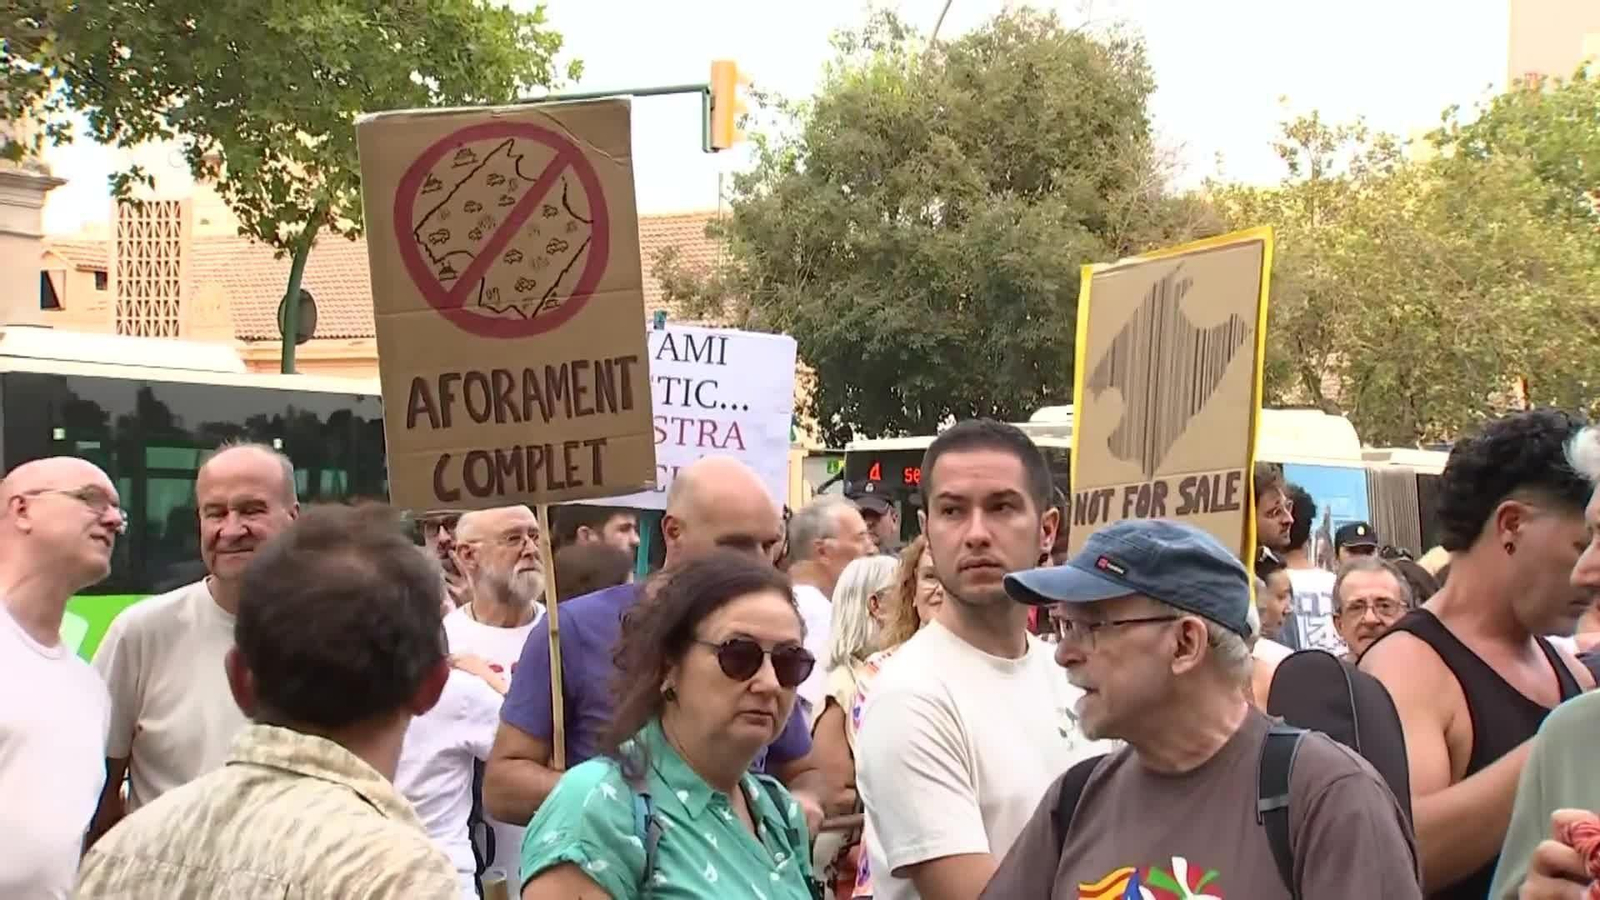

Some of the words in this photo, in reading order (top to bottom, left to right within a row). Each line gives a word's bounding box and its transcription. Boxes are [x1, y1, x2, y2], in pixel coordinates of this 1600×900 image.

[649, 332, 730, 366] AMI
[406, 355, 638, 430] AFORAMENT
[651, 374, 749, 412] TIC...
[433, 437, 608, 502] COMPLET
[1074, 488, 1115, 526] NOT
[1121, 480, 1168, 519] FOR
[1176, 471, 1241, 516] SALE
